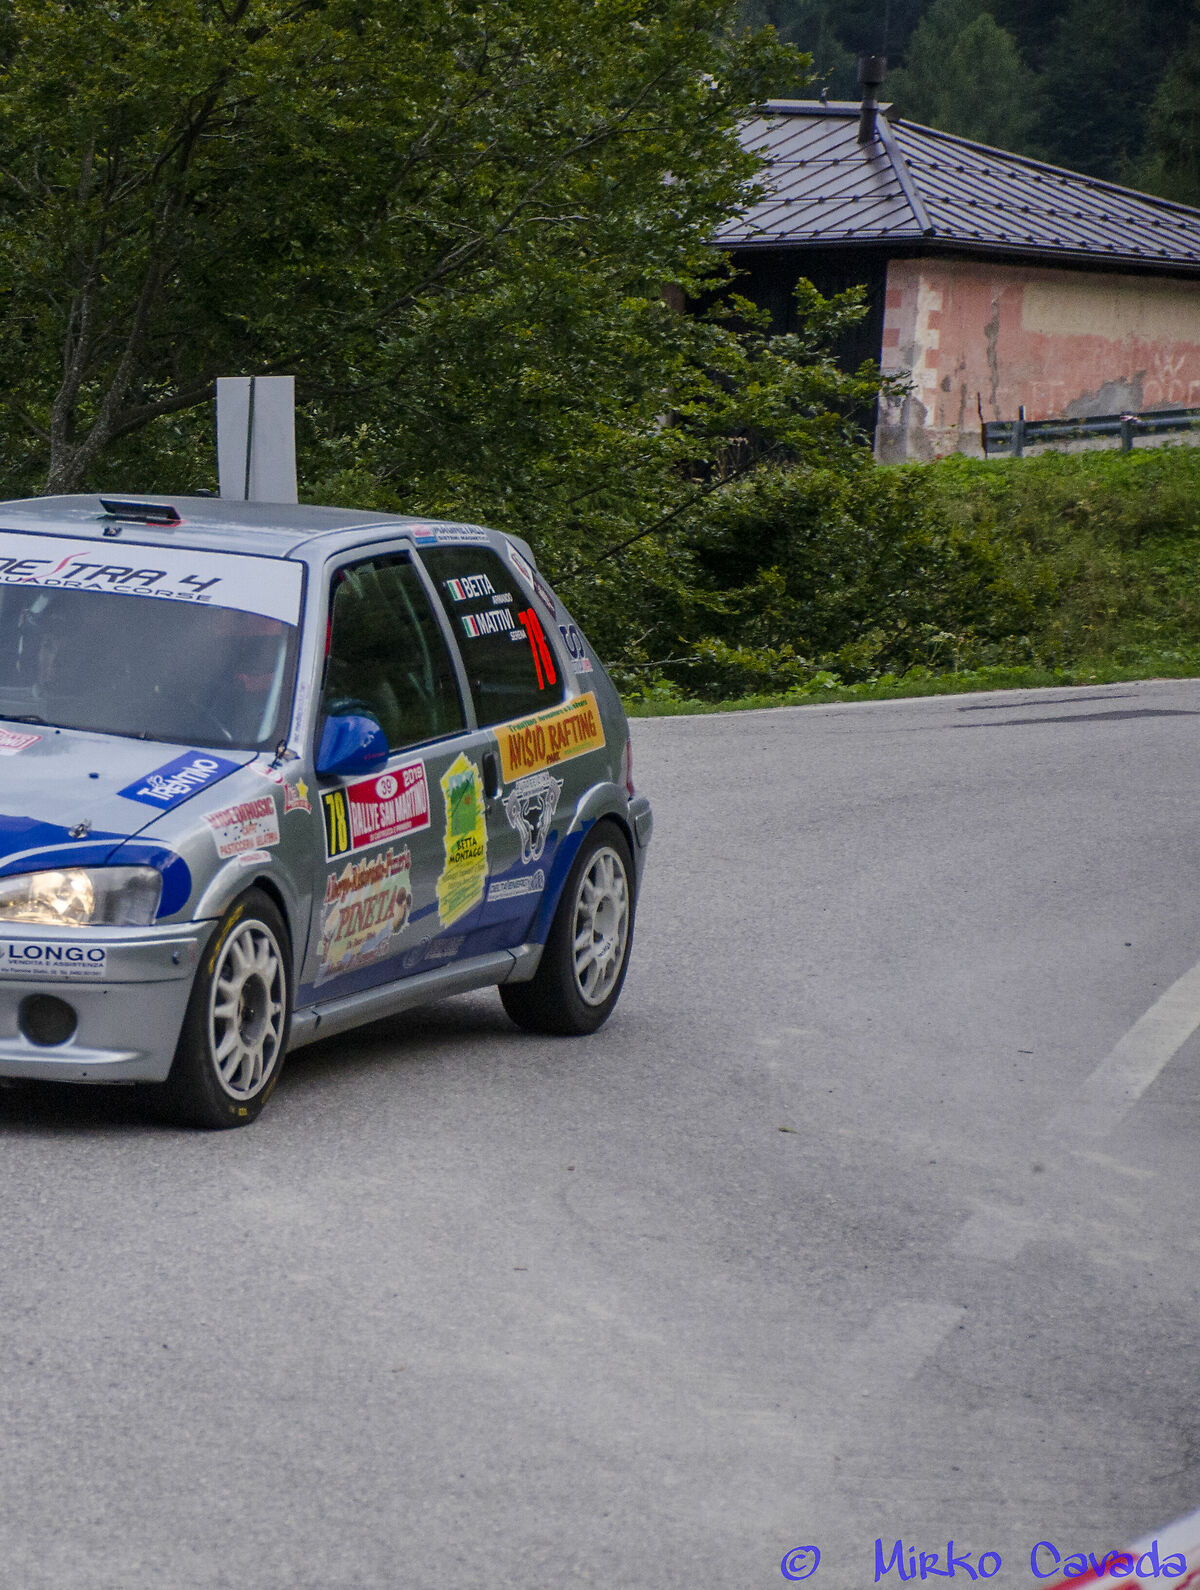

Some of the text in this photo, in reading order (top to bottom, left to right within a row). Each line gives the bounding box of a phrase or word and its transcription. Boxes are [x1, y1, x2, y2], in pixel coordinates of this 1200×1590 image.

[113, 585, 213, 602] CORSE
[178, 574, 223, 592] 4
[460, 573, 496, 599] BETTA
[475, 608, 516, 635] MATTIVI
[518, 607, 557, 690] 78
[508, 725, 546, 771] AVISIO
[548, 710, 598, 751] RAFTING
[136, 759, 219, 801] TRENTINO
[380, 766, 423, 796] 39 2019
[350, 802, 380, 837] RALLYE
[379, 800, 396, 828] SAN
[395, 780, 427, 823] MARTINO
[325, 792, 348, 855] 78
[449, 846, 484, 863] MONTAGGI
[456, 837, 477, 850] BETTA
[334, 885, 398, 942] PINETA
[8, 944, 106, 962] LONGO
